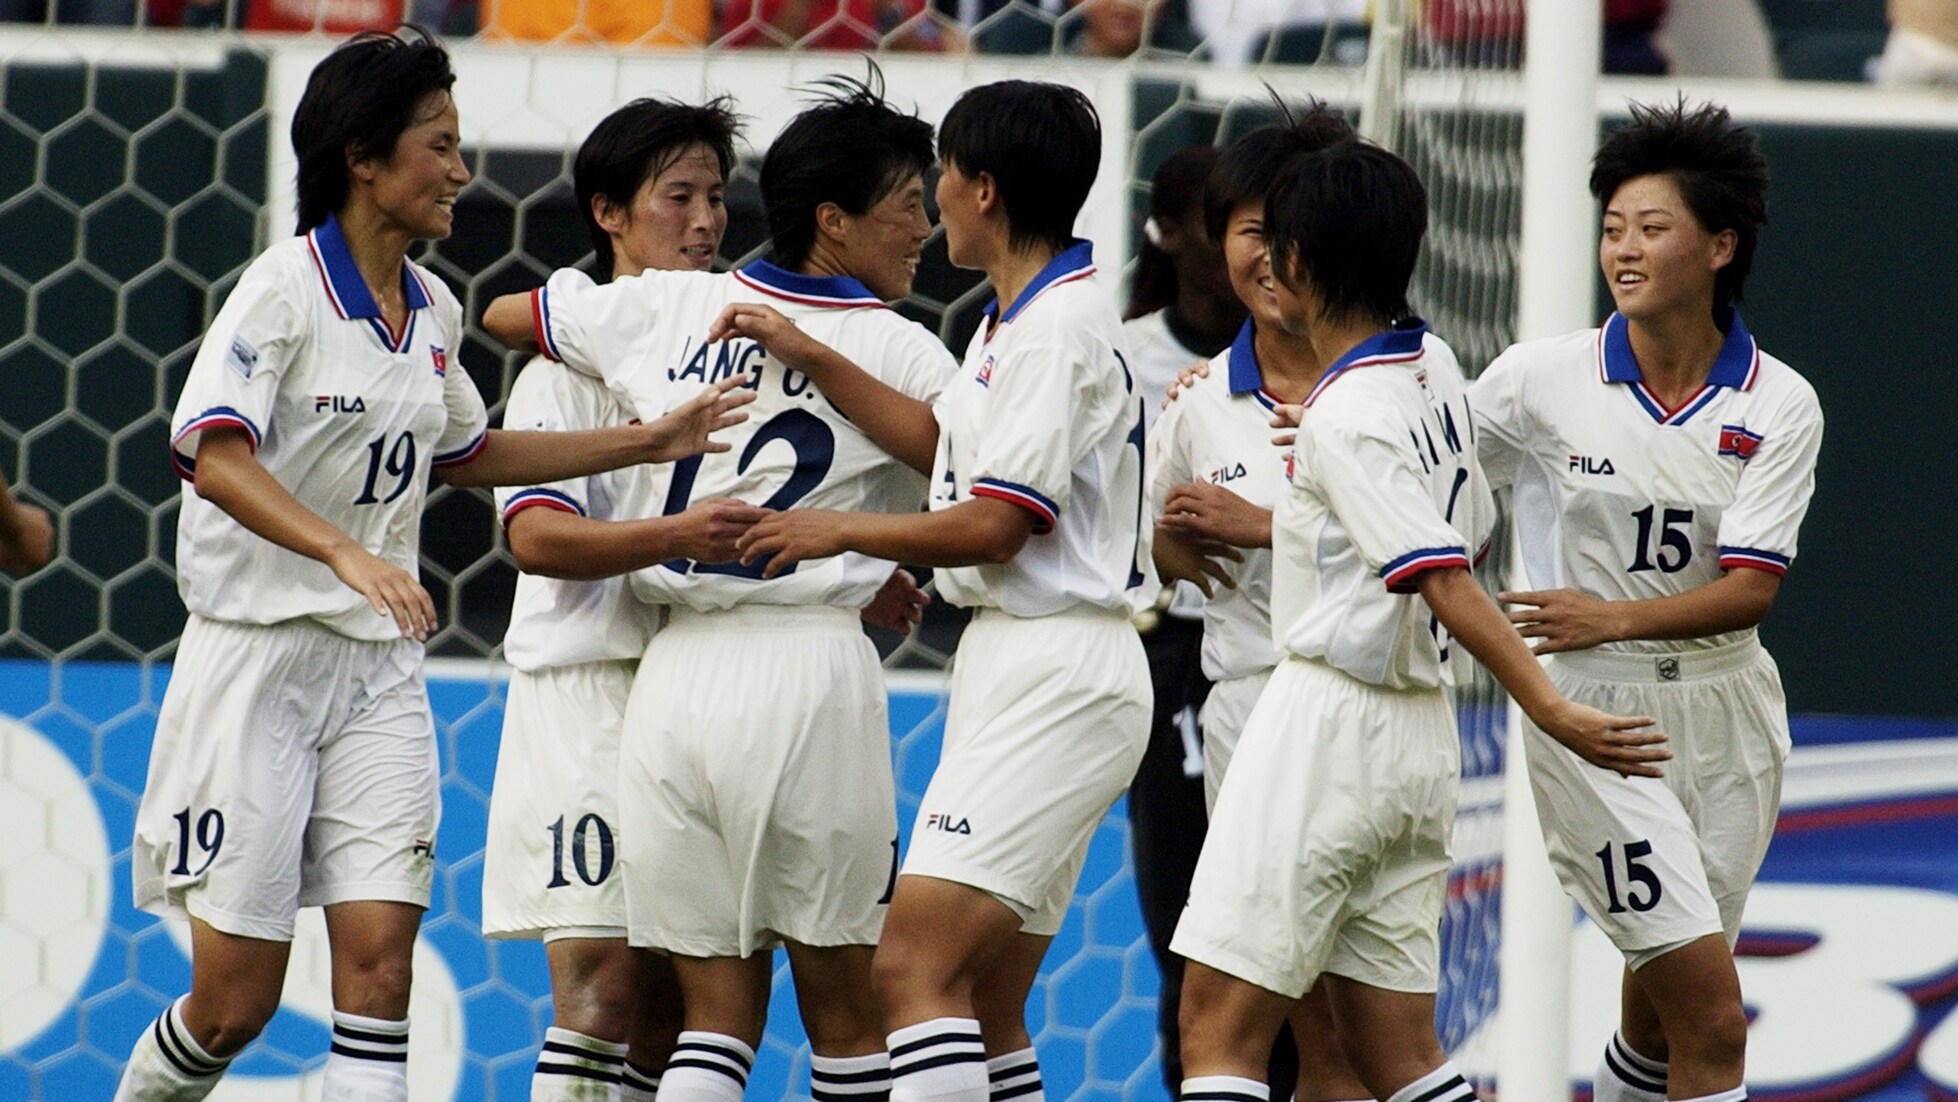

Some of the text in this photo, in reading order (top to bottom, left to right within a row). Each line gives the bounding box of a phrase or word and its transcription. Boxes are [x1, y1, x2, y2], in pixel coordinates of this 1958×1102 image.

[668, 336, 766, 391] JANG
[315, 395, 366, 413] FILA
[353, 430, 416, 505] 19
[1211, 461, 1247, 484] FILA
[1569, 455, 1615, 475] FILA
[1627, 504, 1694, 573] 15
[171, 806, 225, 876] 19
[546, 813, 615, 888] 10
[926, 814, 971, 835] FILA
[1595, 839, 1661, 913] 15
